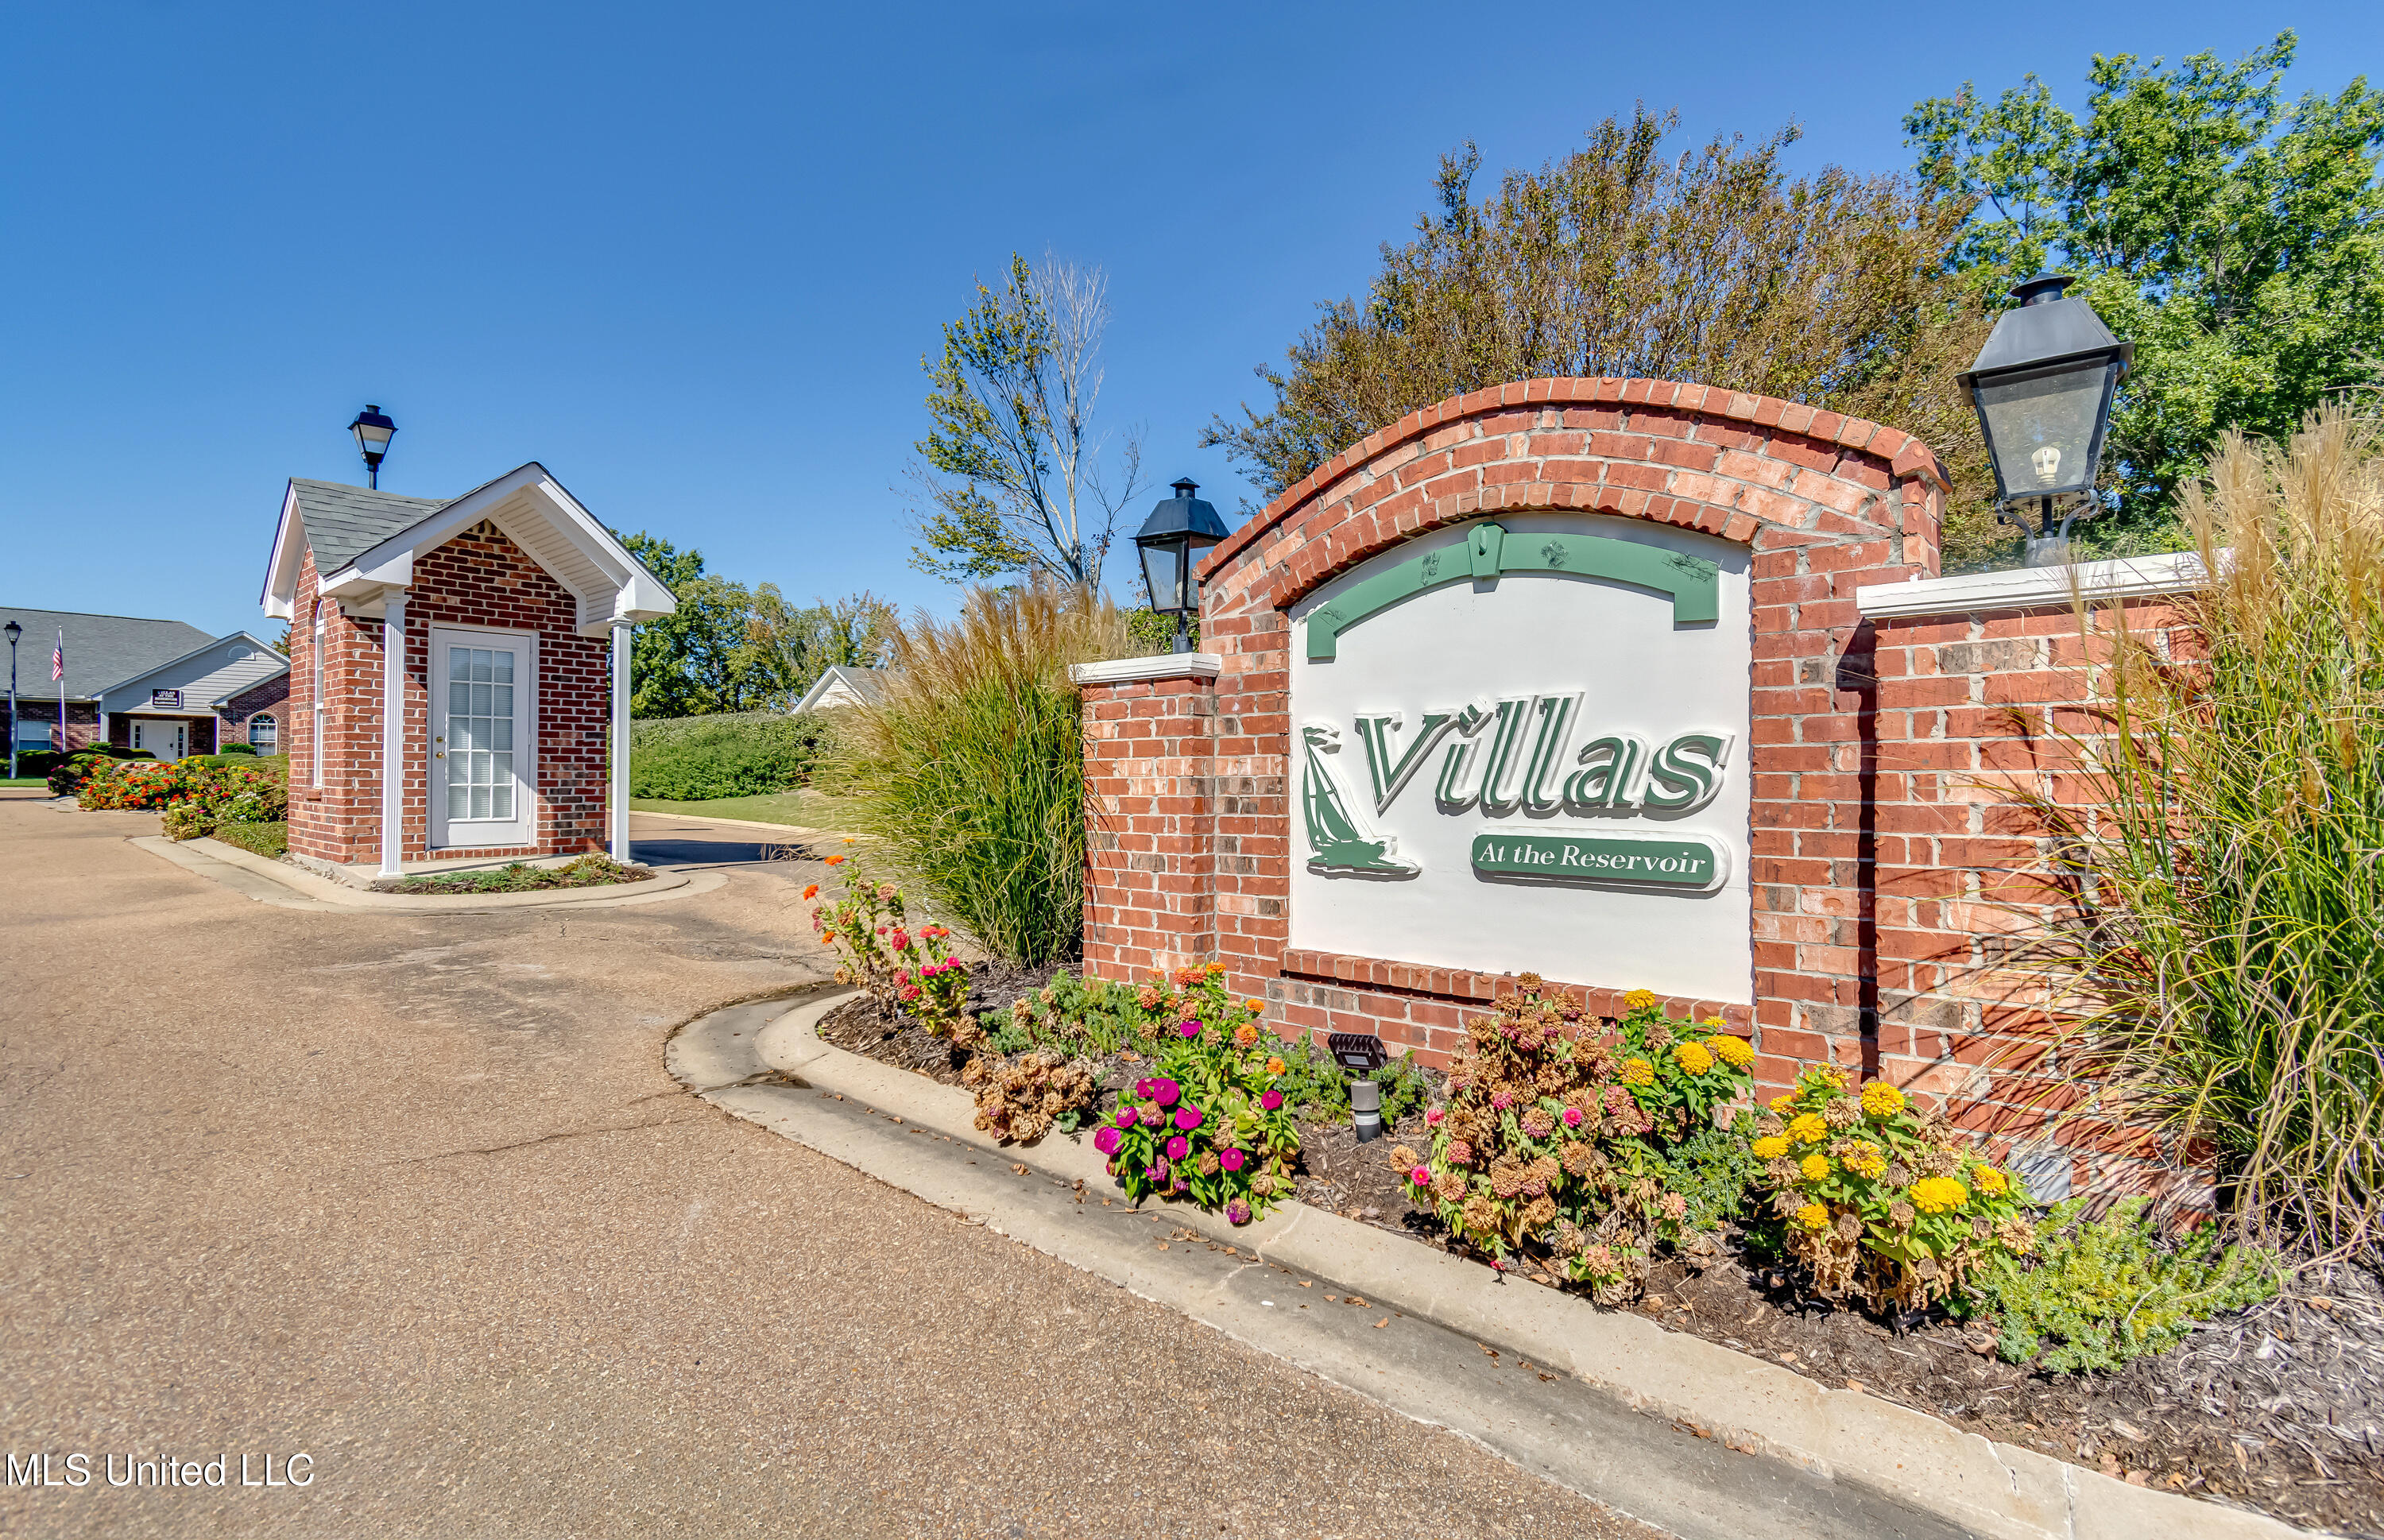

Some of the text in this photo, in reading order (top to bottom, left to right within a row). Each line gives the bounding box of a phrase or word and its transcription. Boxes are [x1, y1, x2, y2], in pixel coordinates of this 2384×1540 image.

[1354, 693, 1731, 817] Villas
[1478, 842, 1706, 873] At the Reservoir
